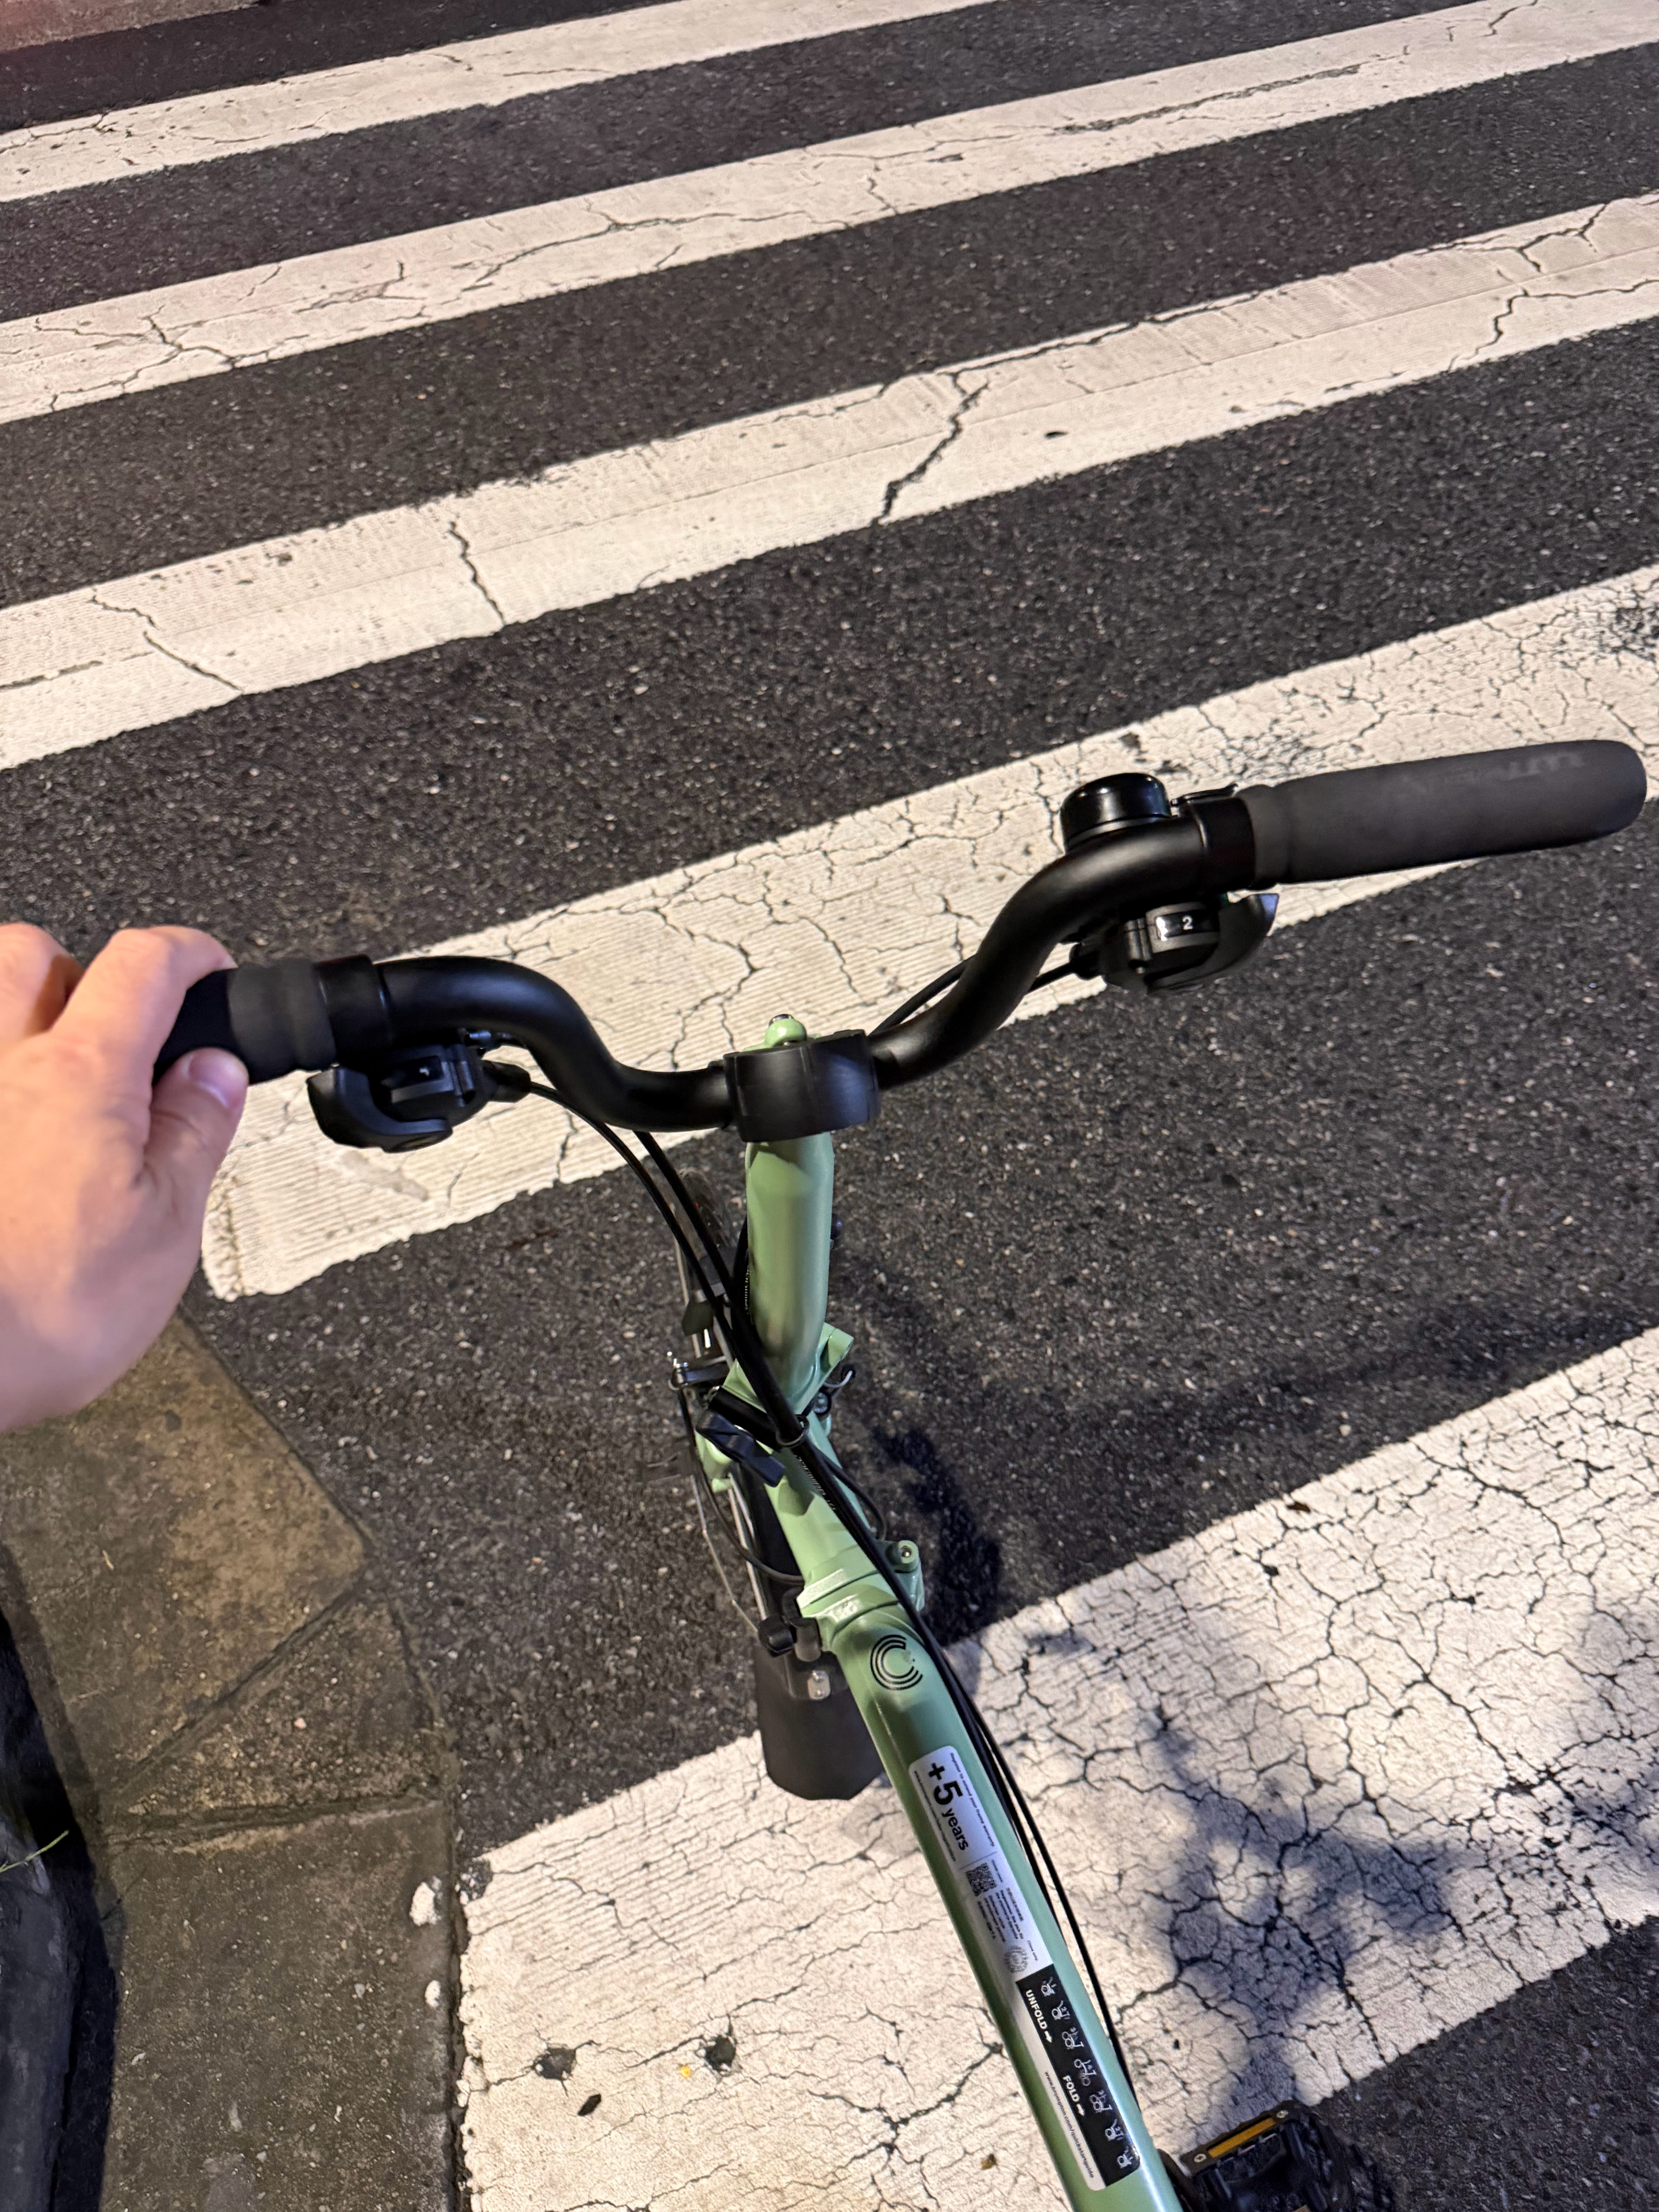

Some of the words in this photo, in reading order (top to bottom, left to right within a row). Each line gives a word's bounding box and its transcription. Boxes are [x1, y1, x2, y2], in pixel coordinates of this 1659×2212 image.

[1182, 915, 1193, 930] 2
[942, 1808, 969, 1850] years
[1025, 1989, 1048, 2030] UNFOLD
[1063, 2075, 1080, 2102] FOLD
